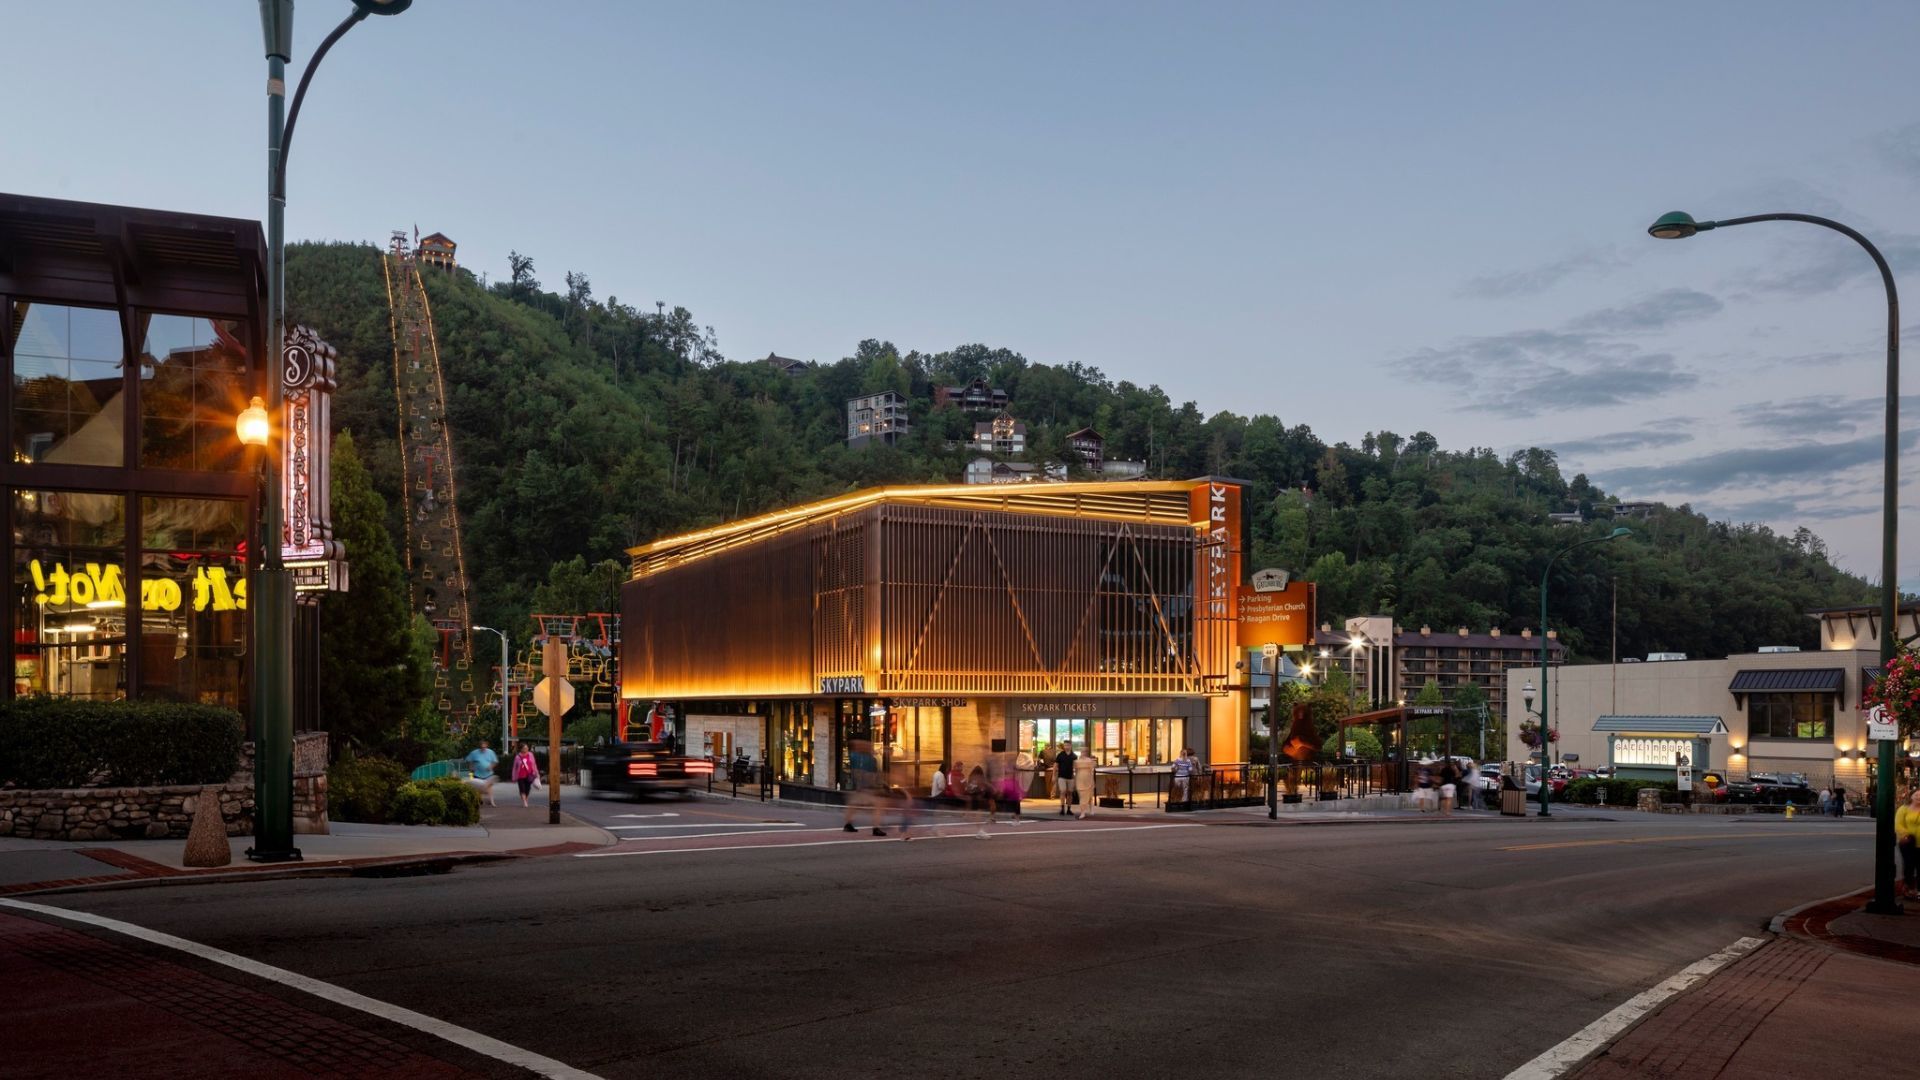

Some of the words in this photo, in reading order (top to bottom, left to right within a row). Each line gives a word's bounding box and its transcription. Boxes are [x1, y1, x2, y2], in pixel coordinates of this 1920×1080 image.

[293, 405, 306, 547] SUGARLANDS
[1247, 595, 1272, 603] Parking
[1247, 604, 1284, 614] Presbyterian
[1284, 603, 1306, 611] Church
[1247, 615, 1271, 623] Reagan
[1272, 613, 1290, 621] Drive
[820, 677, 864, 693] SKYPARK
[893, 699, 938, 707] SKYPARK
[941, 699, 967, 707] SHOP
[1022, 703, 1060, 712] SKYPARK
[1063, 703, 1097, 712] TICKETS
